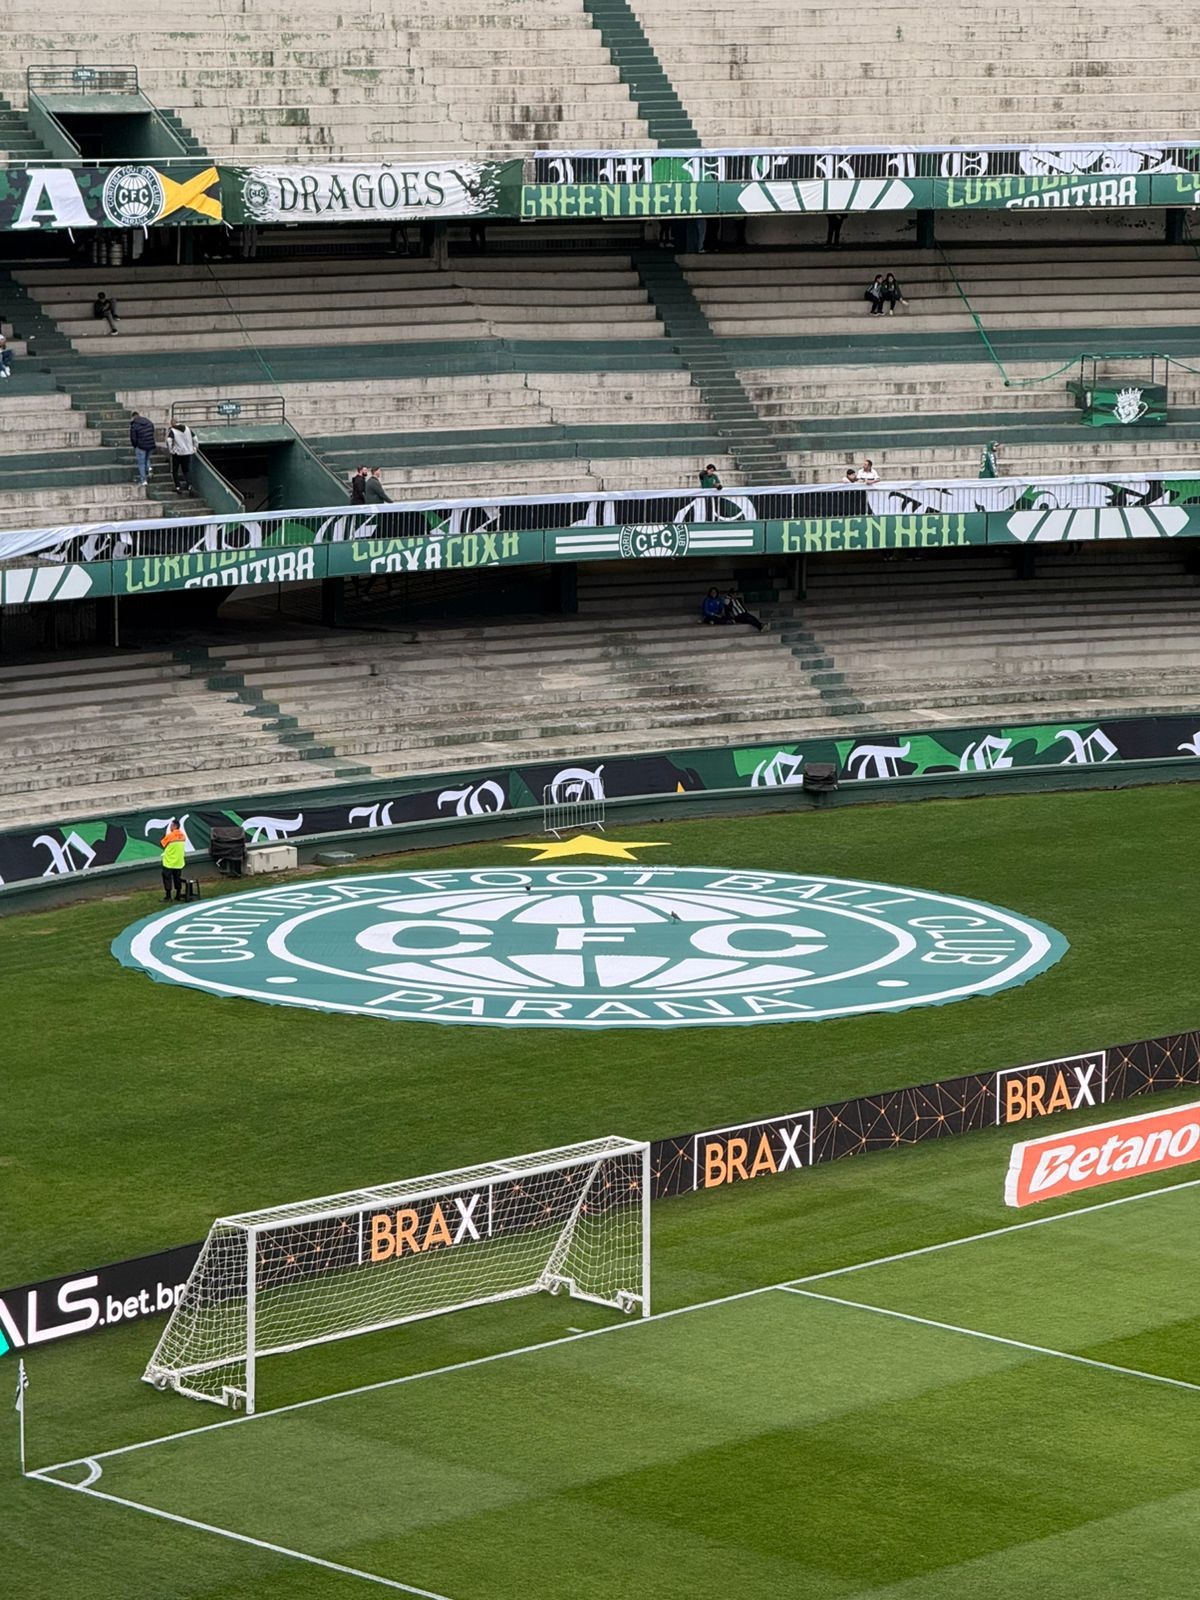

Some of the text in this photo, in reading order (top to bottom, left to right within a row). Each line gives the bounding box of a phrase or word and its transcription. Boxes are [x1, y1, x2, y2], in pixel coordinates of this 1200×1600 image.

[12, 168, 98, 228] A
[119, 188, 149, 204] CFC
[277, 162, 445, 214] DRAGÕES
[521, 181, 702, 217] GREEN HELL
[636, 529, 673, 551] CFC
[781, 513, 971, 554] GREEN HELL
[164, 871, 1016, 965] CORITIBA FOOT BALL CLUB
[365, 989, 816, 1018] PARANÁ
[1006, 1063, 1096, 1123] BRAX
[704, 1124, 803, 1188] BRAX
[1028, 1123, 1200, 1194] Betano
[371, 1194, 481, 1263] BRAX
